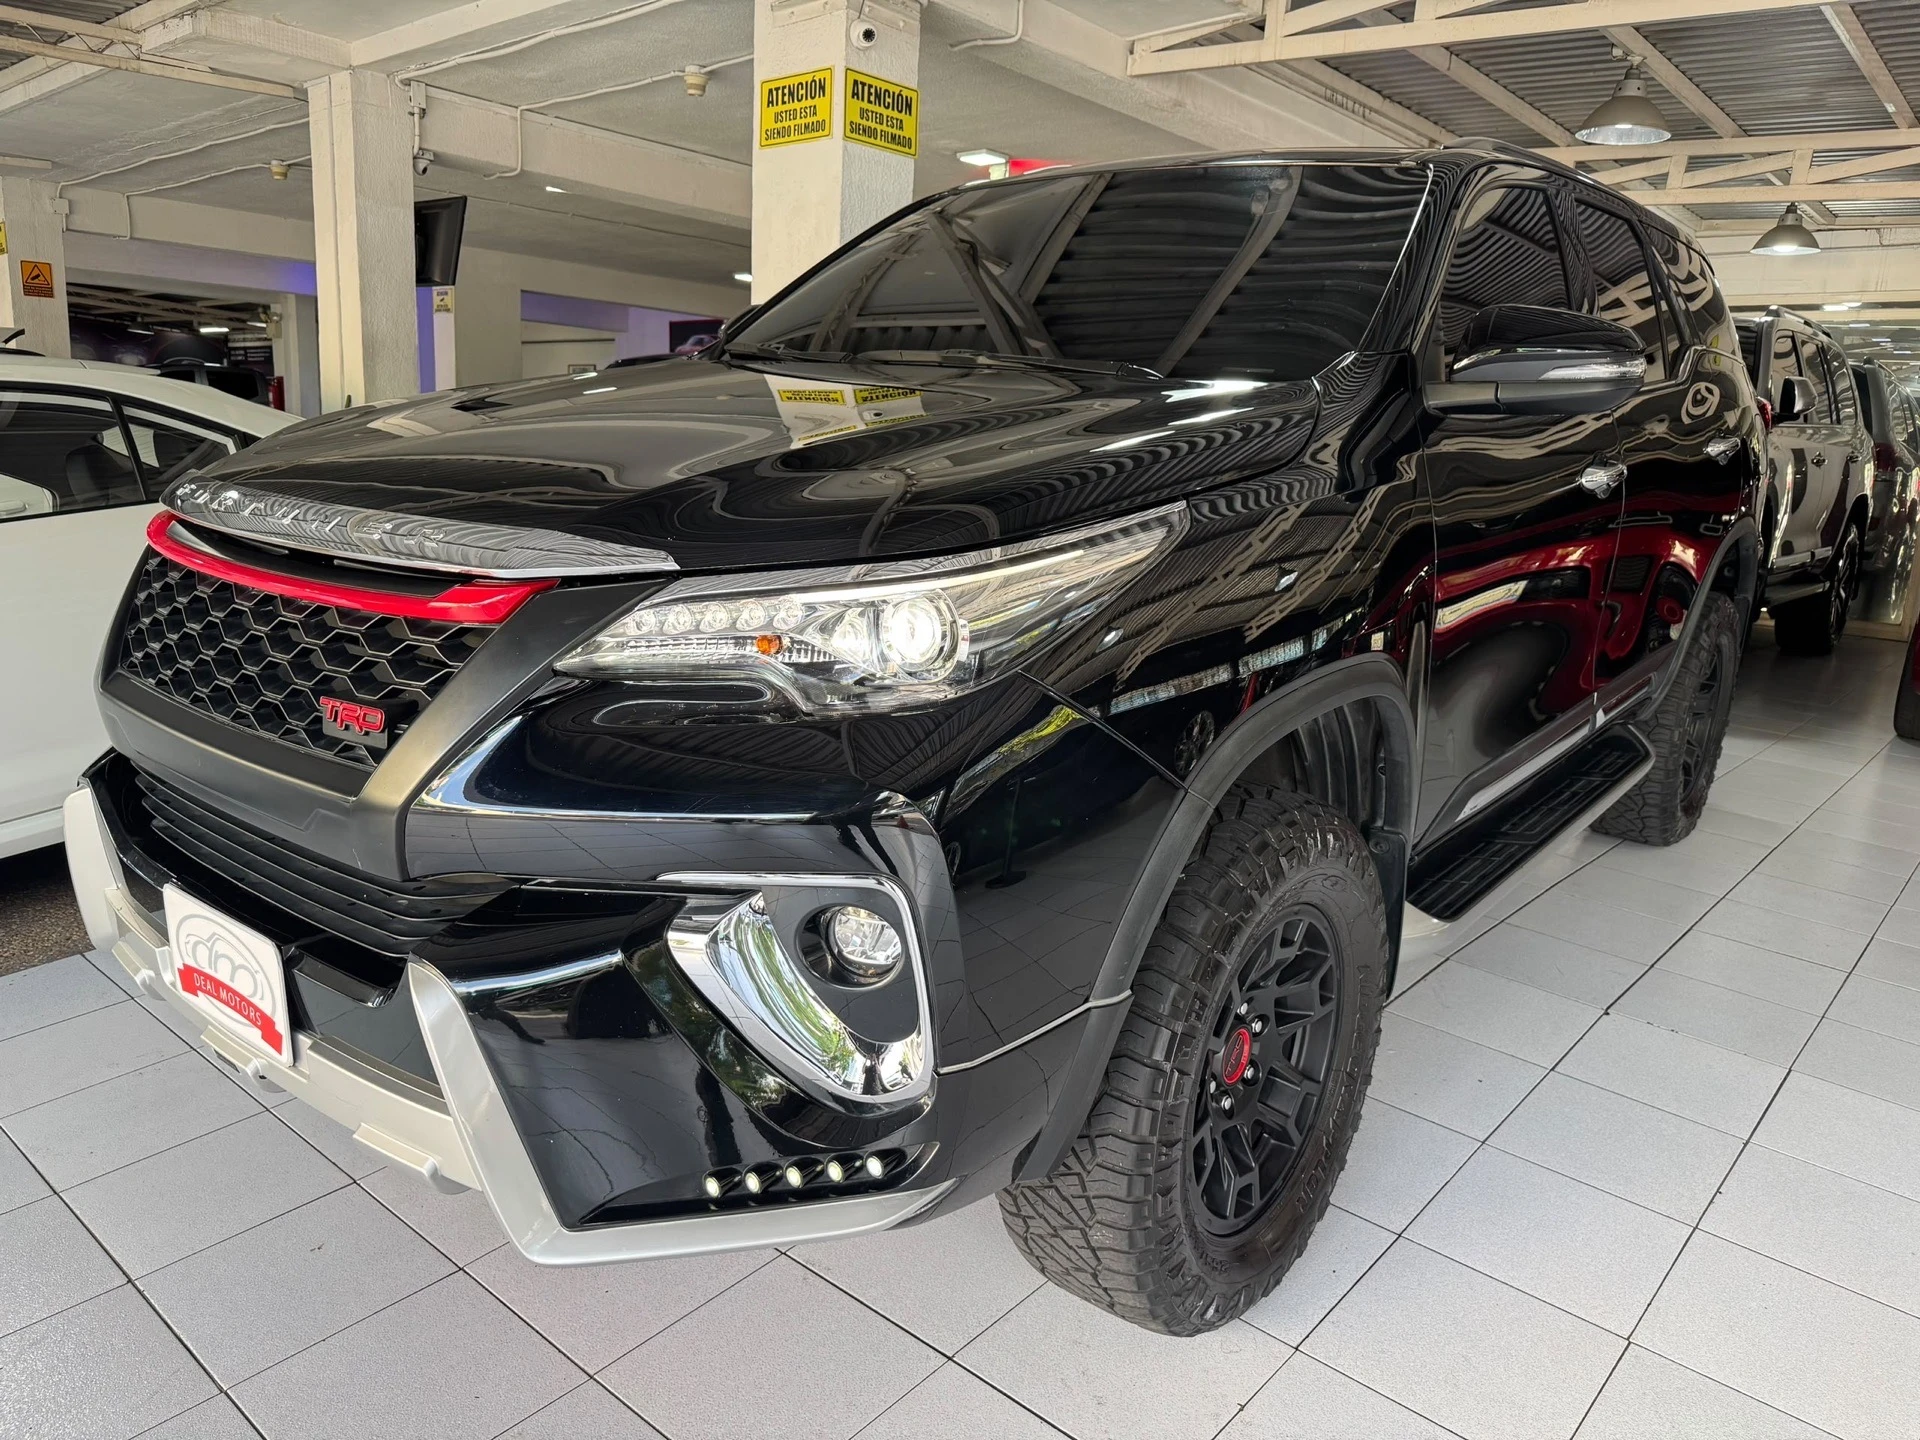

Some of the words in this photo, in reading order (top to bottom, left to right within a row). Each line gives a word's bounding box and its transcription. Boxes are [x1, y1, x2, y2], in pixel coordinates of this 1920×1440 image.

[766, 75, 826, 108] ATENCIÓN
[851, 78, 913, 117] ATENCIÓN
[764, 125, 792, 141] SIENDO
[793, 119, 826, 137] FILMADO
[774, 107, 798, 124] USTED
[799, 104, 818, 120] ESTA
[859, 106, 885, 126] USTED
[885, 117, 904, 132] ESTA
[849, 120, 878, 140] SIENDO
[879, 130, 913, 150] FILMADO
[319, 695, 386, 736] TRD
[192, 972, 219, 998] DEAL
[219, 987, 263, 1027] MOTORS
[1225, 1034, 1243, 1077] TRD
